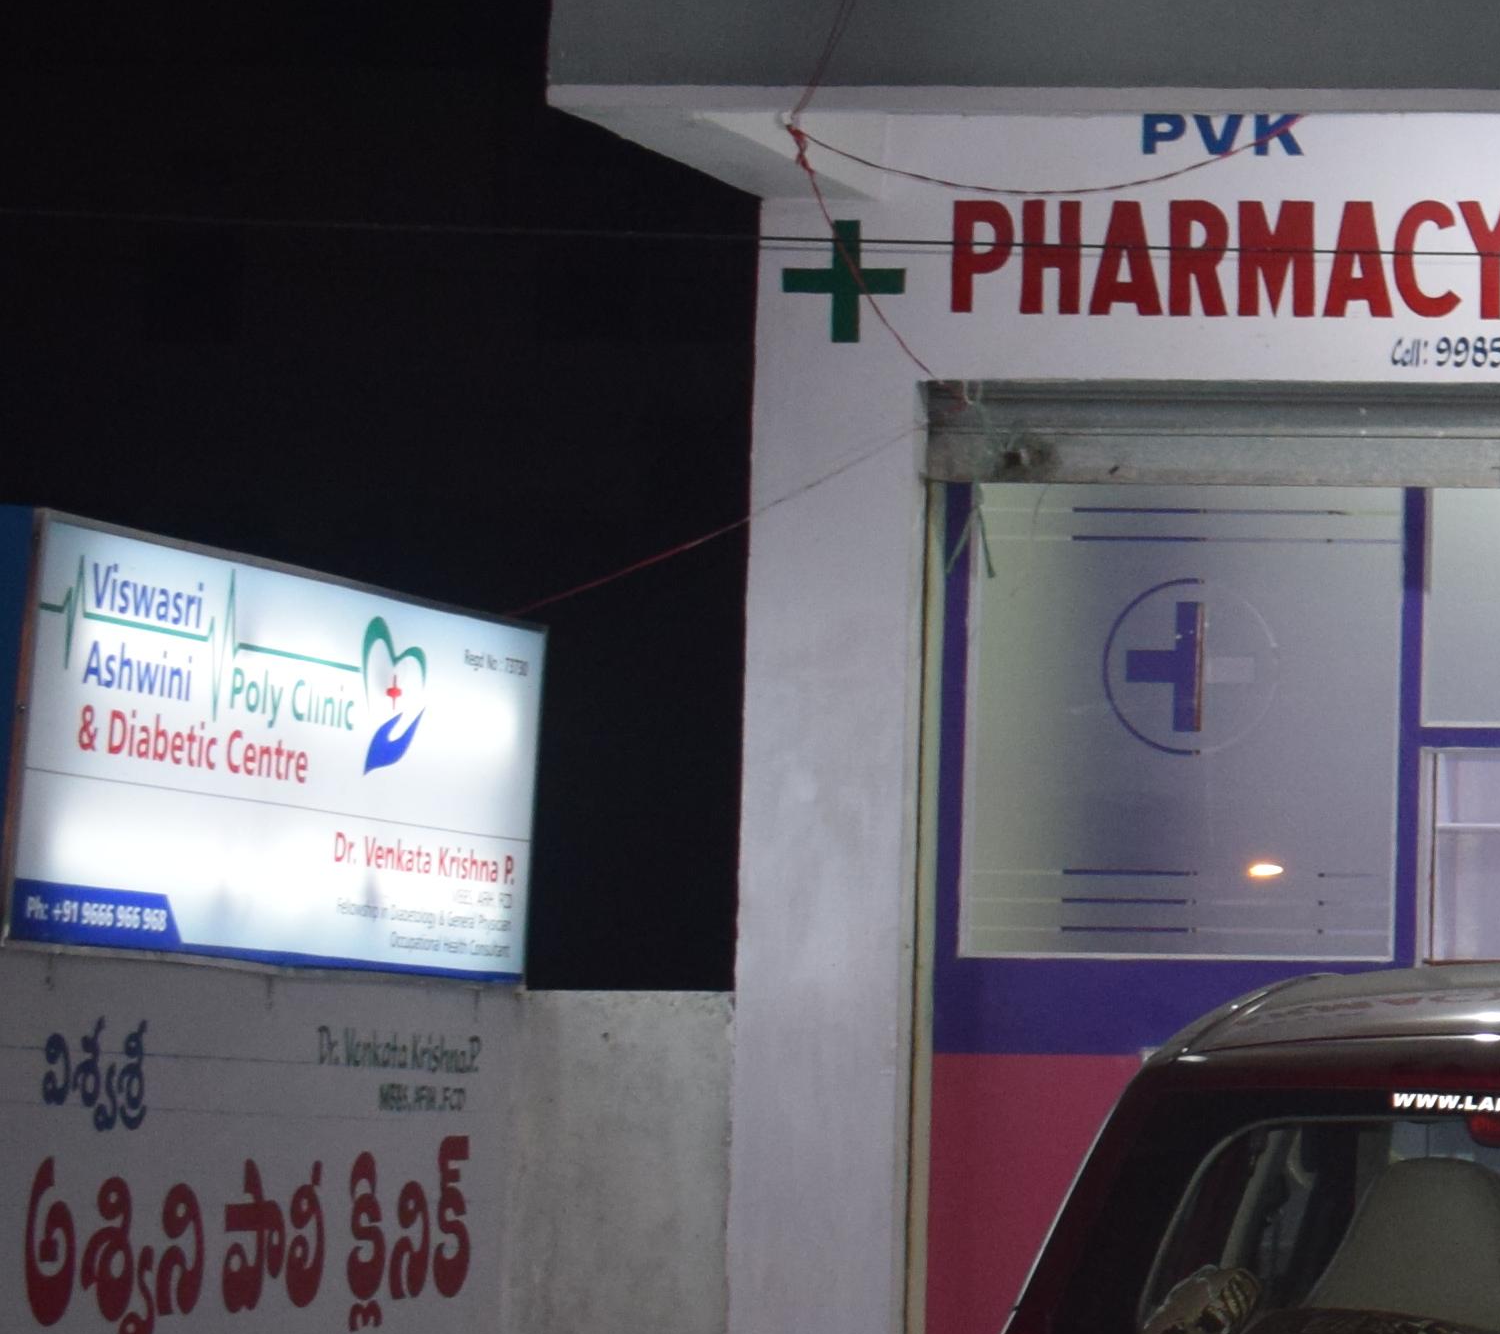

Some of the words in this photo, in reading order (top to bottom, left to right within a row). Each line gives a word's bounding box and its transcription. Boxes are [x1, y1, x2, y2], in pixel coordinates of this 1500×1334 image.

[1141, 115, 1303, 156] PVK
[92, 562, 204, 629] Viswasri
[83, 640, 193, 702] Ashwini
[229, 667, 282, 729] Poly
[291, 680, 354, 731] Clinic
[78, 703, 97, 752] &
[107, 710, 217, 771] Diabetic
[226, 729, 309, 784] Centre
[334, 831, 356, 864] Dr.
[364, 835, 432, 874] Venkata
[437, 846, 498, 884] Krishna
[504, 855, 515, 885] P.
[52, 900, 79, 923] +91
[81, 901, 115, 927] 9666
[116, 904, 141, 930] 966
[142, 907, 167, 932] 968
